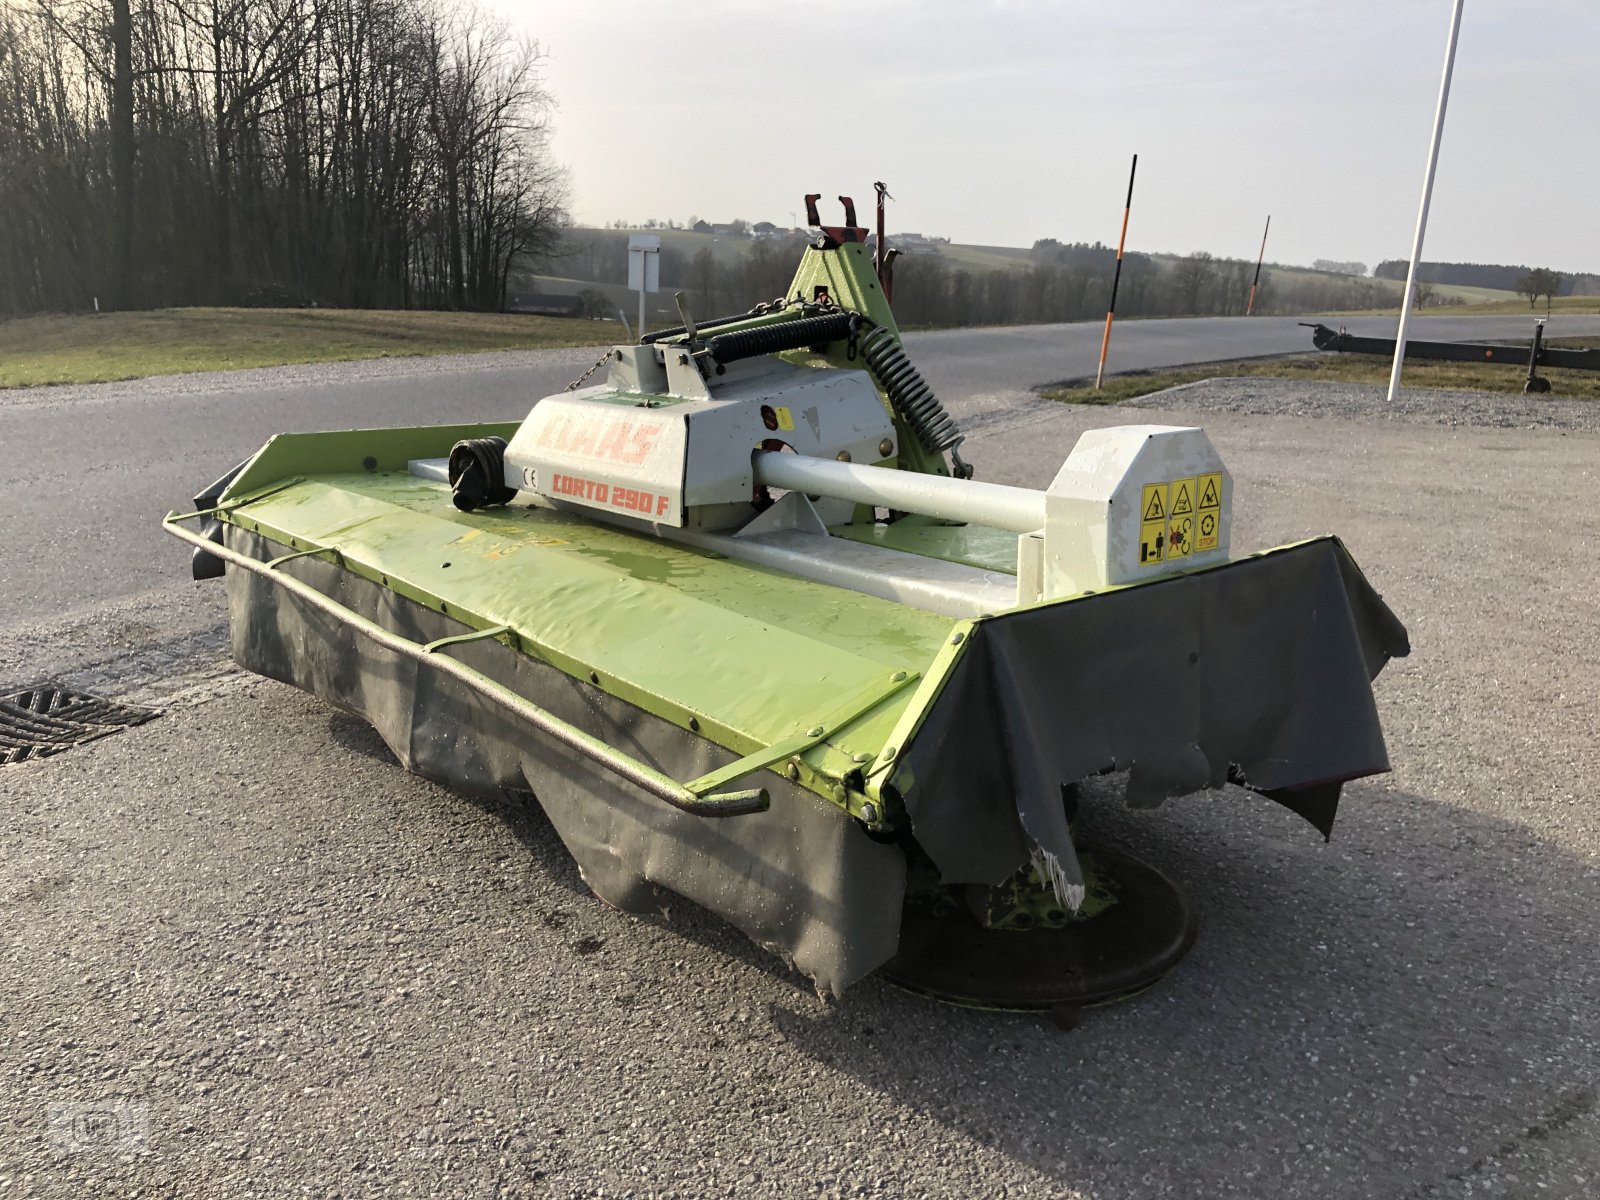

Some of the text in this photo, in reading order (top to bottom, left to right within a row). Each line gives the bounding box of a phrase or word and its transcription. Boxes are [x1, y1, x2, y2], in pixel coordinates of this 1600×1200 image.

[537, 413, 659, 465] CLAAS
[523, 468, 536, 487] CE
[553, 474, 670, 516] CORTO 290 F
[1198, 536, 1216, 547] STOP
